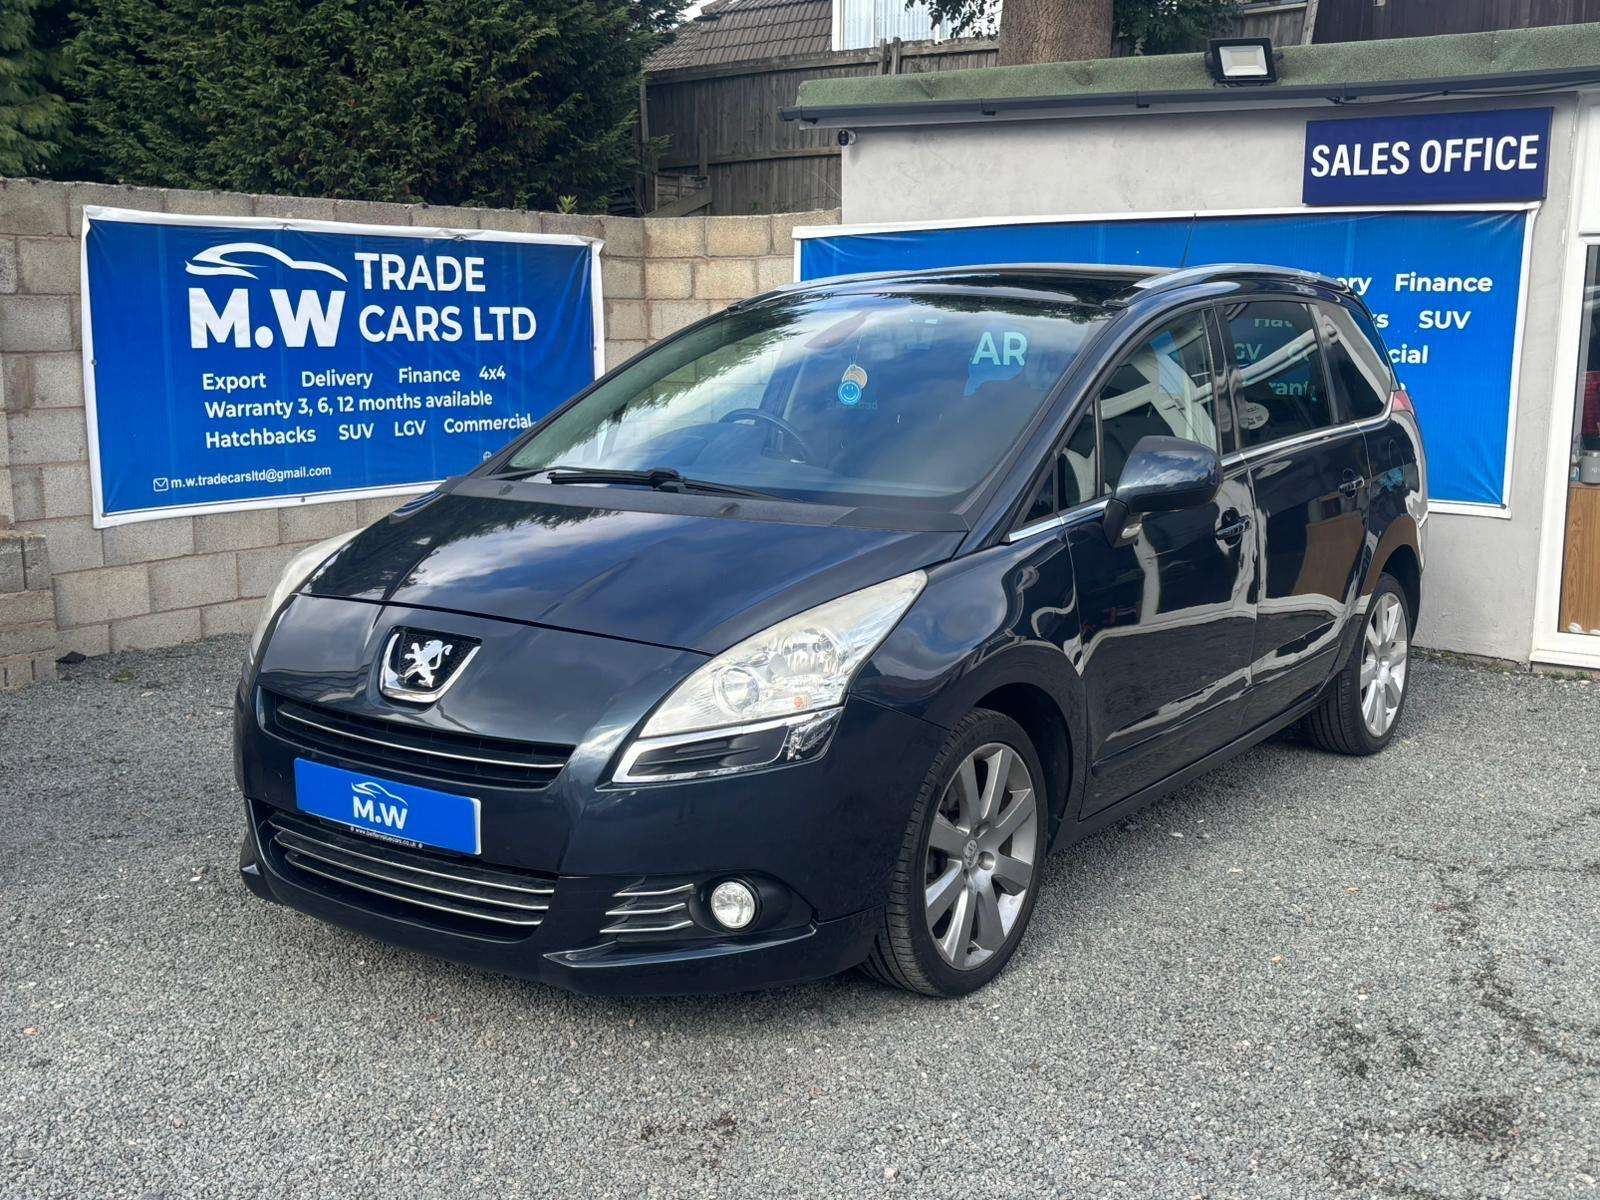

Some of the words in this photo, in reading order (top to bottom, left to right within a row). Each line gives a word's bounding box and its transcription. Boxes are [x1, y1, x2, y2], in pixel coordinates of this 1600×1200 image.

[1311, 141, 1410, 177] SALES
[1420, 135, 1539, 173] OFFICE
[355, 253, 486, 292] TRADE
[1395, 272, 1493, 292] Finance
[189, 288, 346, 348] M.W
[359, 305, 463, 343] CARS
[474, 306, 537, 341] LTD
[1418, 310, 1472, 330] SUV
[202, 373, 267, 394] Export
[301, 368, 373, 390] Delivery
[398, 367, 461, 384] Finance
[479, 365, 506, 381] 4x4
[204, 398, 293, 419] Warranty
[298, 397, 313, 417] 3,
[317, 396, 333, 415] 6,
[337, 396, 355, 413] 12
[359, 393, 422, 412] months
[426, 390, 493, 409] available
[205, 426, 317, 449] Hatchbacks
[338, 423, 374, 441] SUV
[394, 420, 426, 437] LGV
[443, 413, 532, 434] Commercial
[170, 466, 332, 489] m.w.tradecarsltd@gmail.com
[353, 797, 407, 829] M.W
